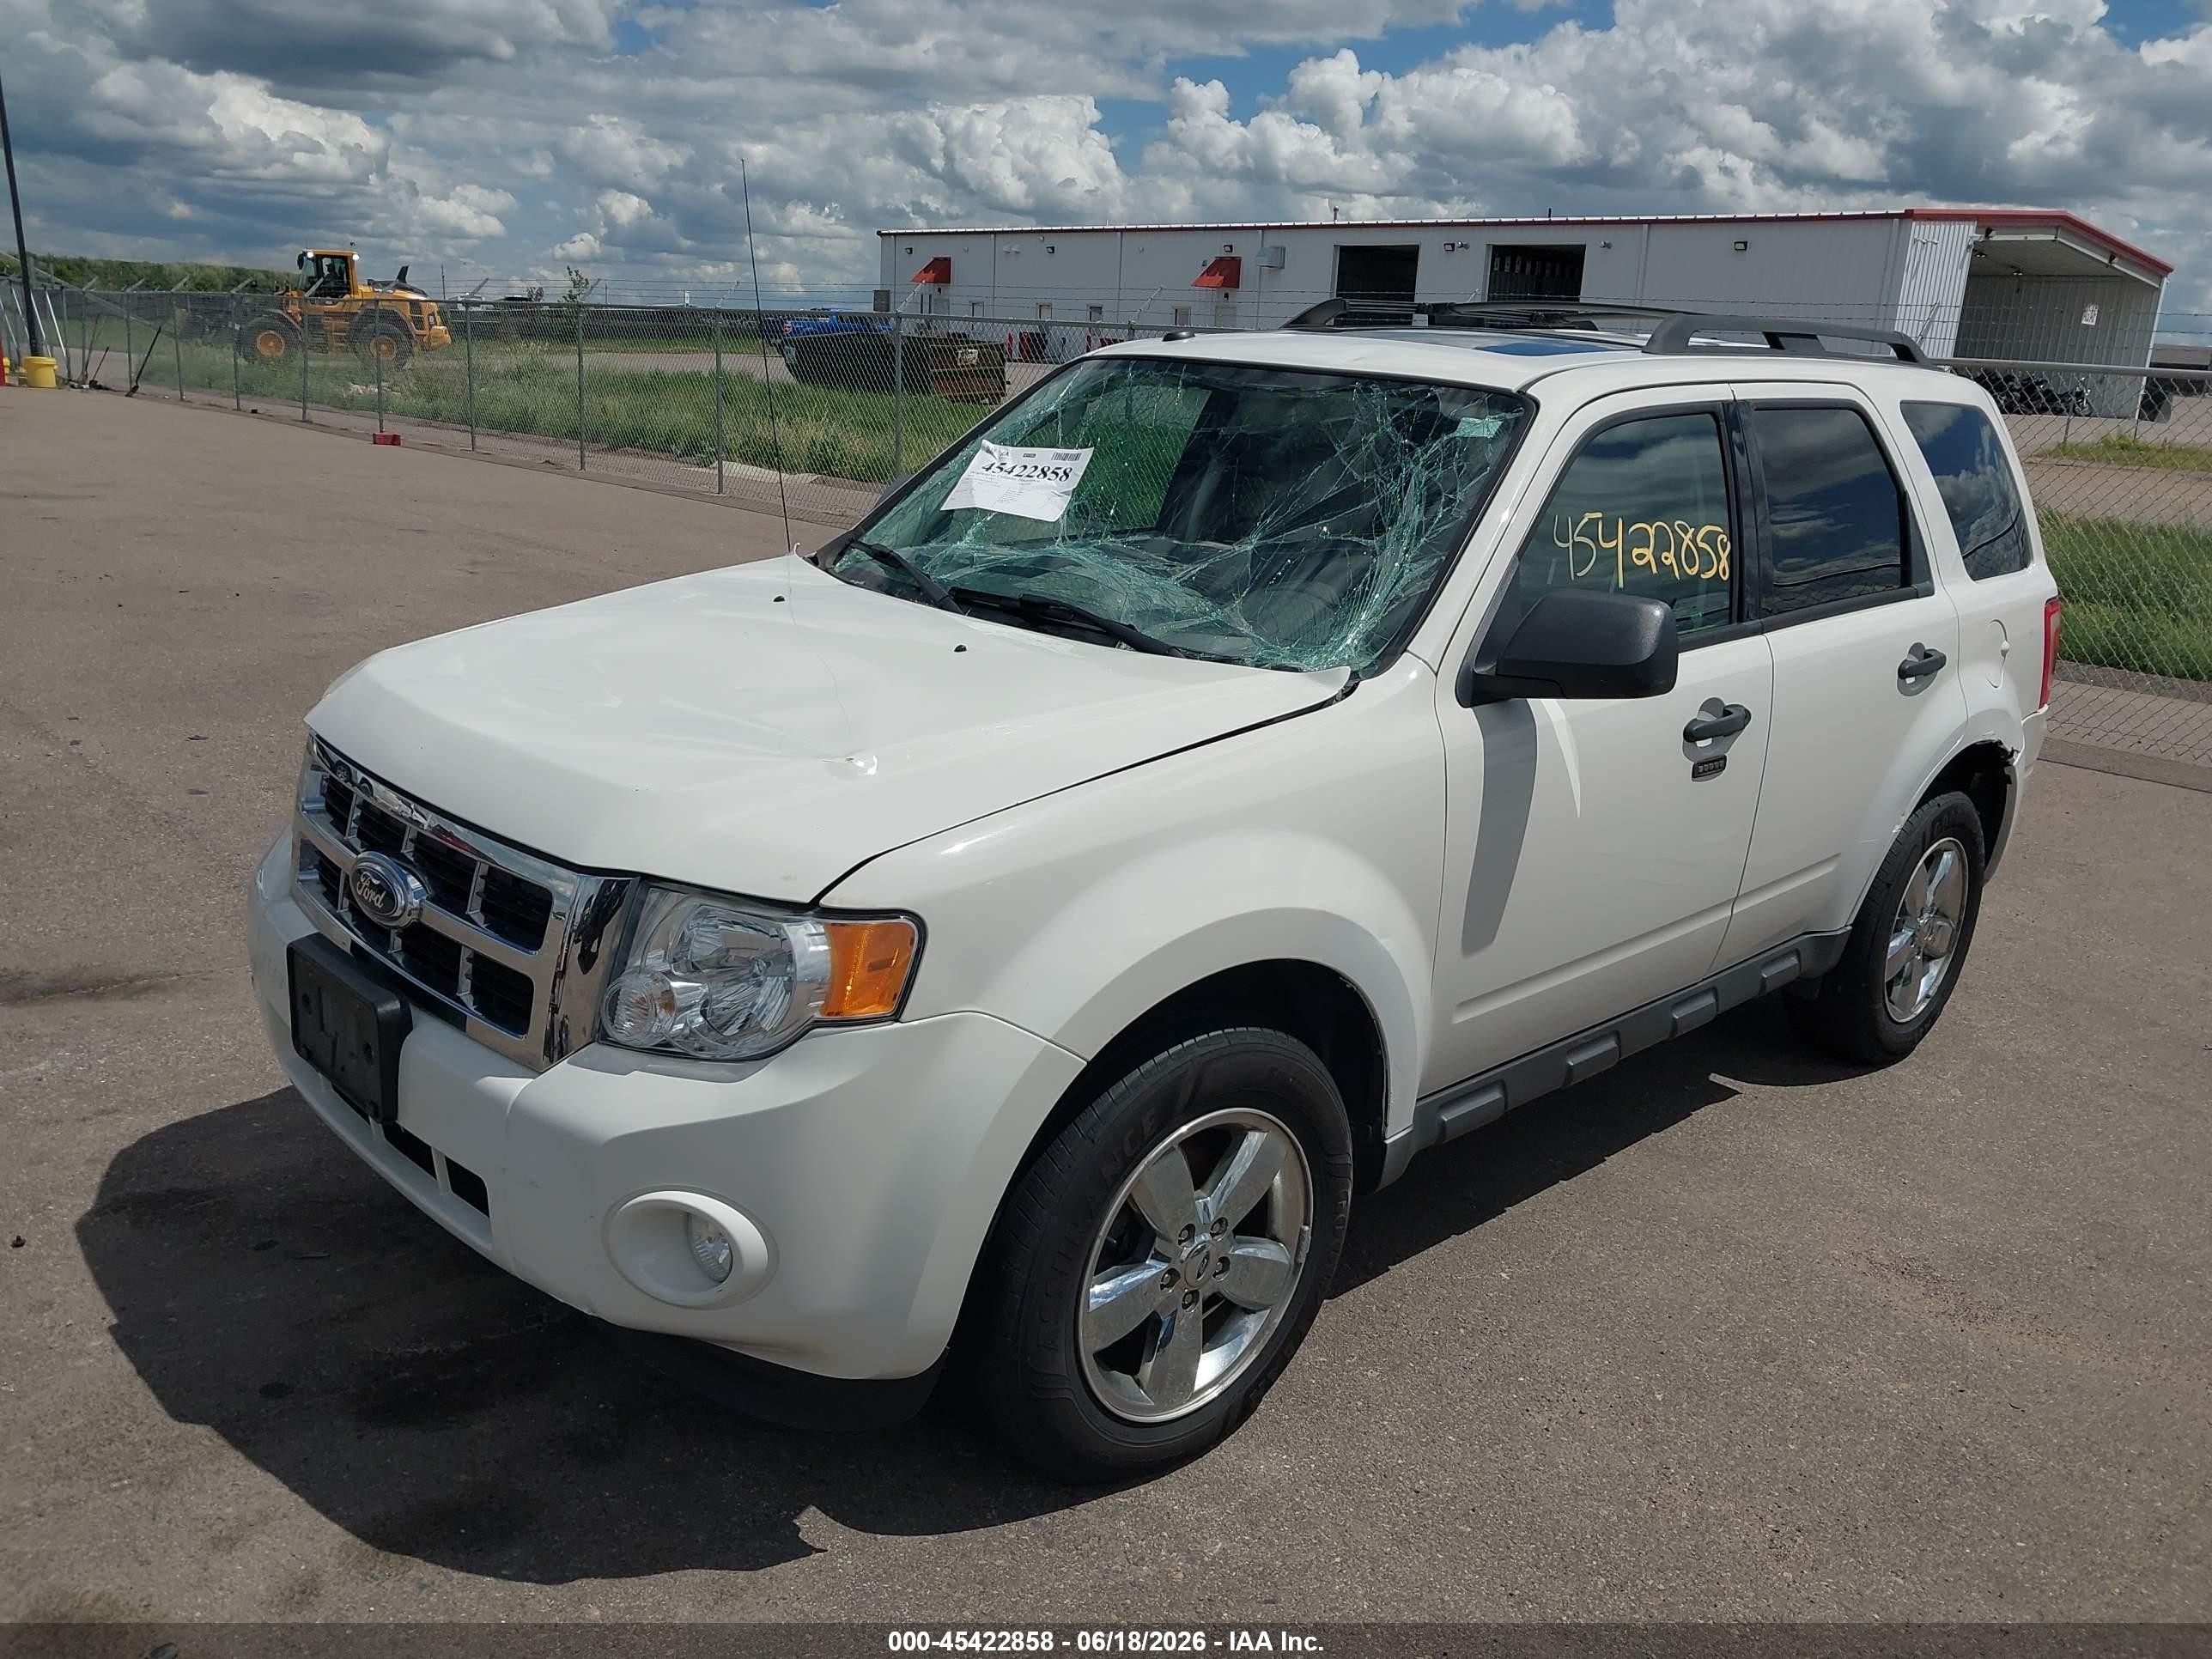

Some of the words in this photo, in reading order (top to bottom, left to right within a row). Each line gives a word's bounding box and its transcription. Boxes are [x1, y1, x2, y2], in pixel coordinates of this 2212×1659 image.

[981, 461, 1073, 483] 45422858
[1553, 510, 1731, 589] 45422858
[356, 871, 386, 909] Ford
